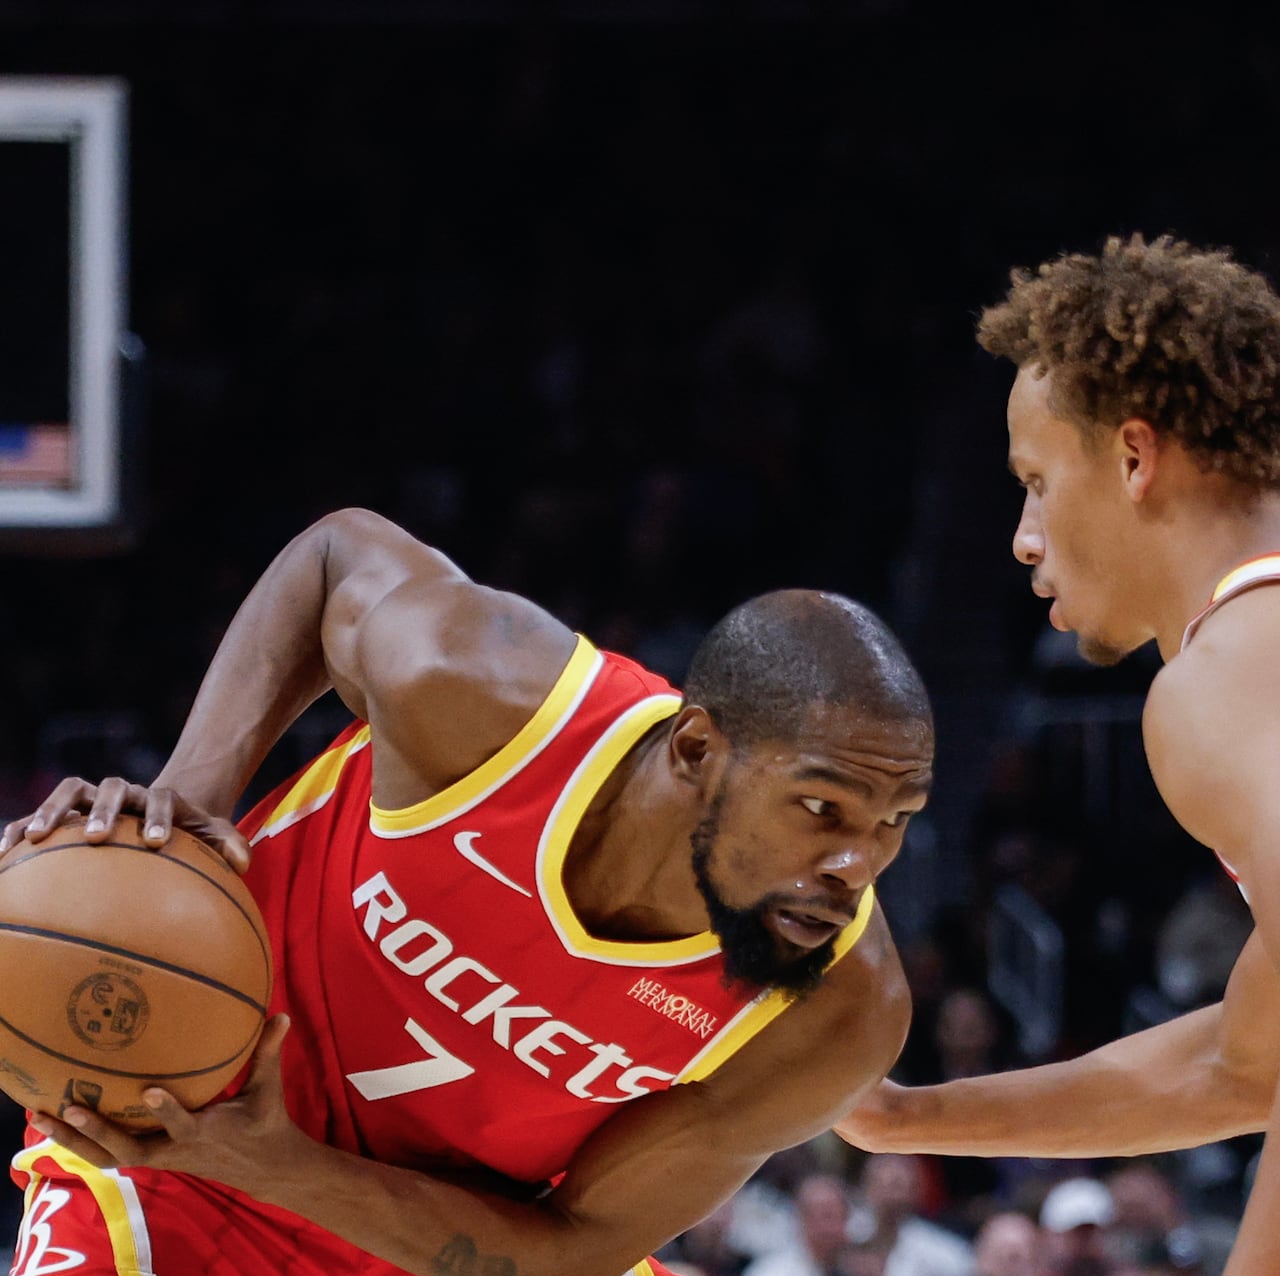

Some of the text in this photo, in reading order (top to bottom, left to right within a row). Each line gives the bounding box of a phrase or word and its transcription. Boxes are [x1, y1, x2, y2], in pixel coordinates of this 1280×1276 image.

[626, 987, 714, 1039] HERMANN
[634, 977, 717, 1031] MEMORIAL
[346, 1017, 475, 1101] 7
